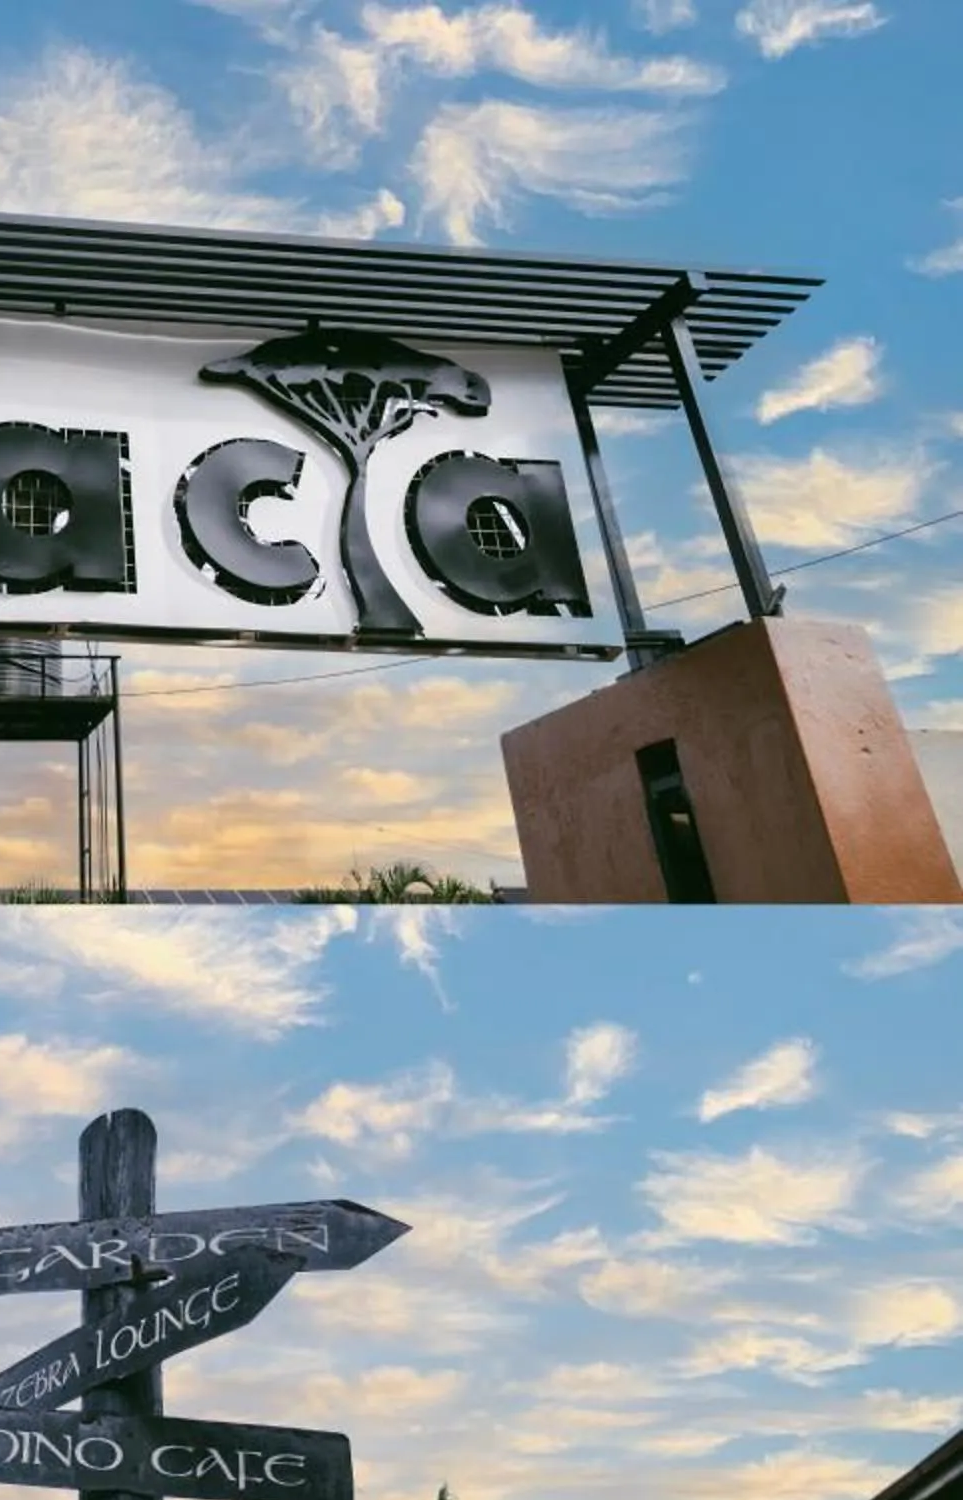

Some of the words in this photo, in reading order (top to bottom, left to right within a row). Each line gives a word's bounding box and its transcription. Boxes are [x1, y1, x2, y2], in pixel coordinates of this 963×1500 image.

[0, 1352, 81, 1408] ZEBRA
[95, 1272, 240, 1369] LOUNGE
[150, 1444, 307, 1491] CAFE
